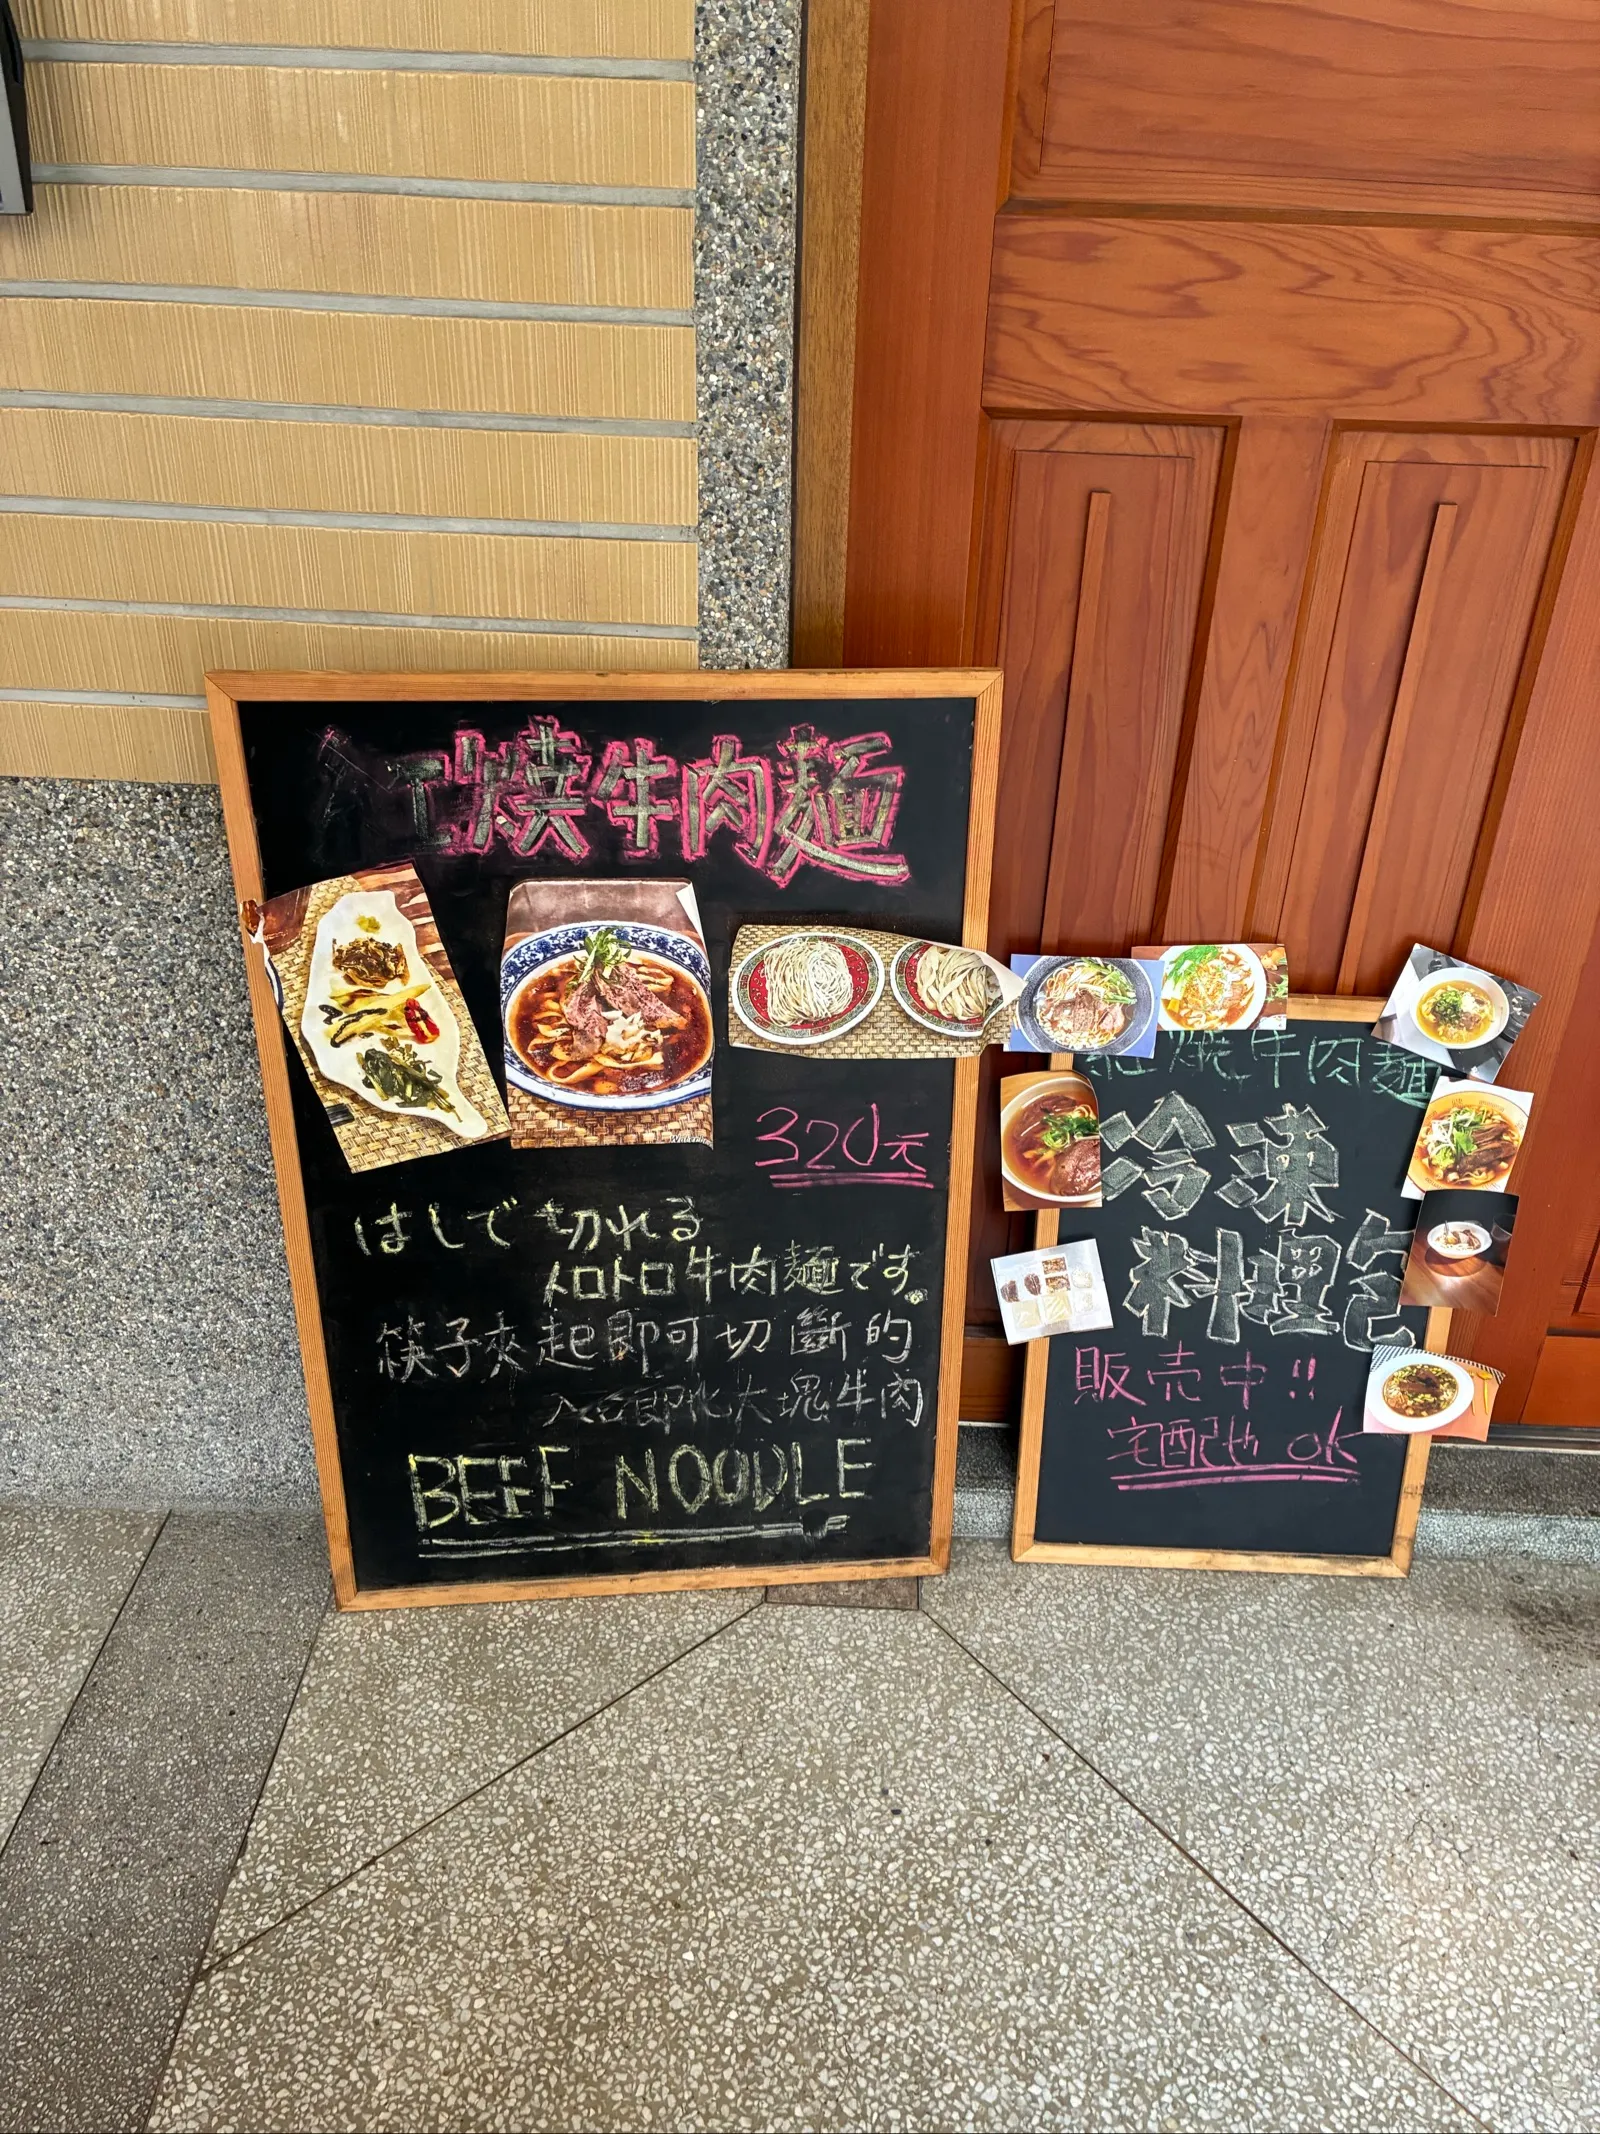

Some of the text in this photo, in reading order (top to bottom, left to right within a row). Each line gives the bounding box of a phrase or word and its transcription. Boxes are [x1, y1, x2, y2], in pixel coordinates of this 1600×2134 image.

[754, 1102, 930, 1172] 320元
[1122, 1207, 1416, 1353] 料理包
[407, 1437, 877, 1532] BEEF NOODLE
